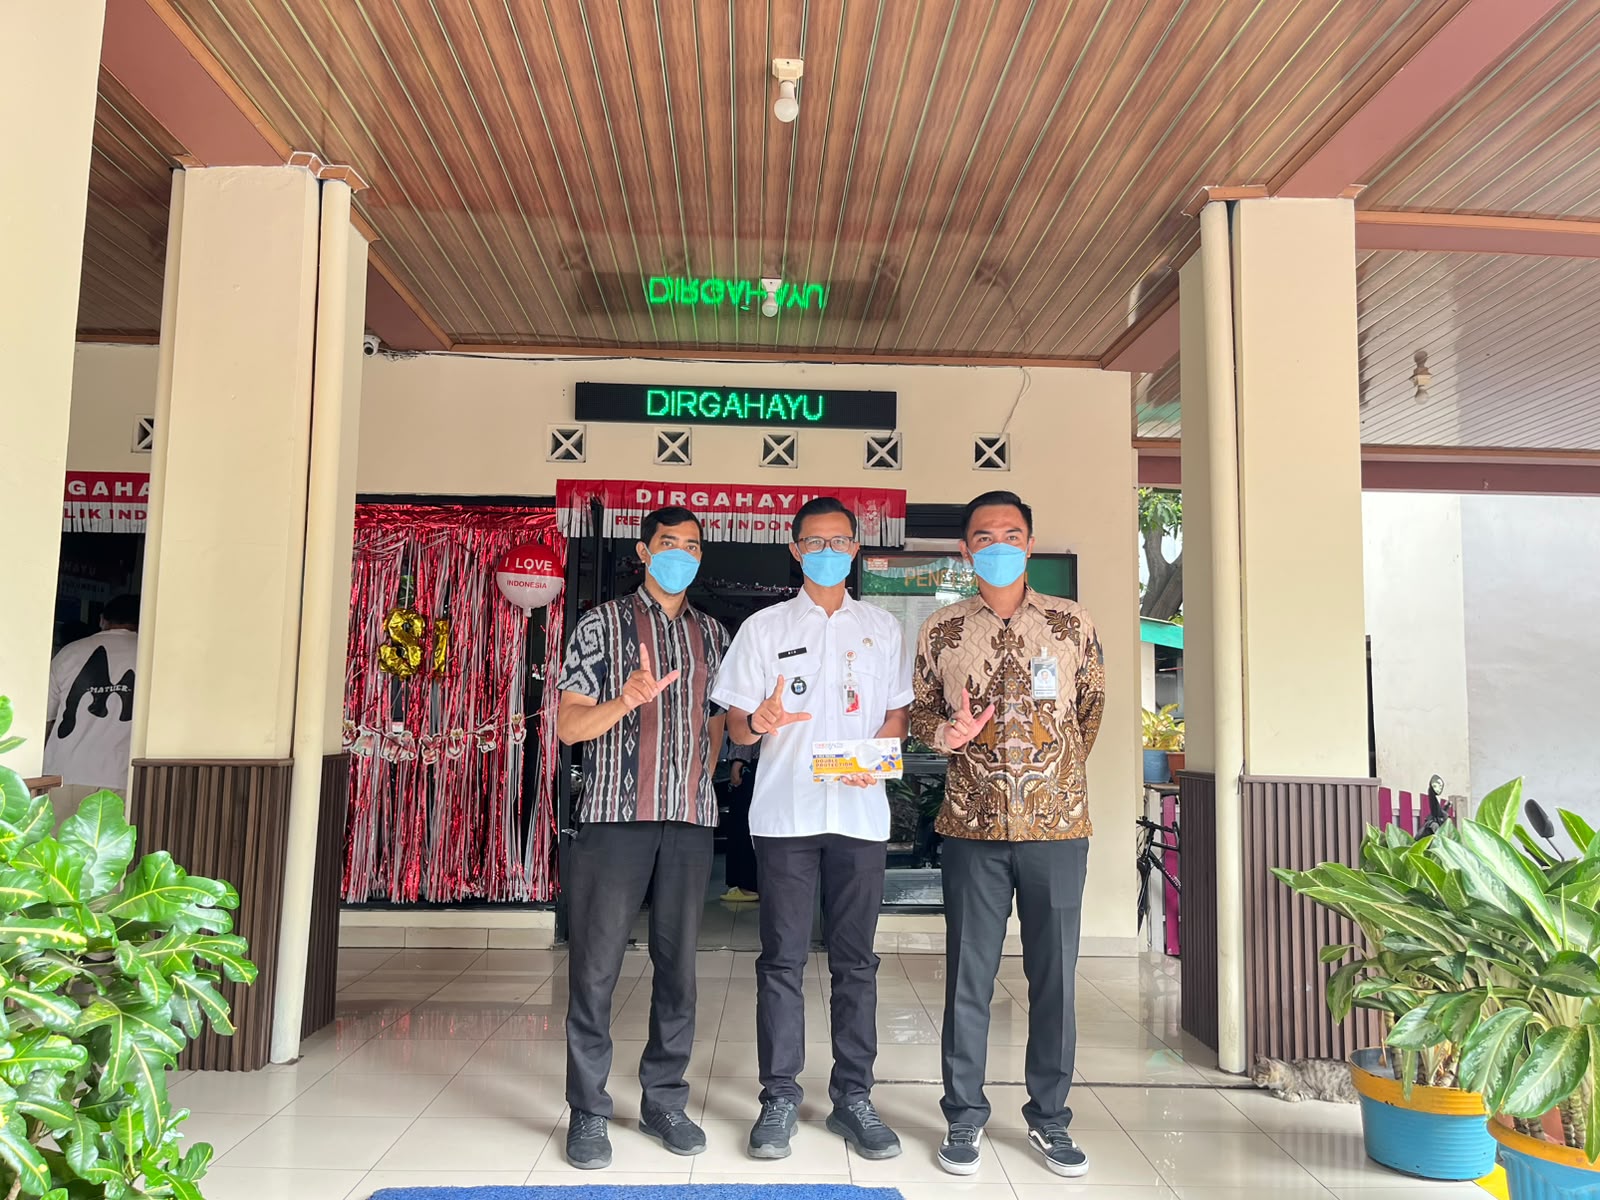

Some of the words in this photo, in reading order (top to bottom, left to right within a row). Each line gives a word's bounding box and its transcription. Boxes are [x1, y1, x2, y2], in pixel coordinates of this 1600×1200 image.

[646, 389, 823, 421] DIRGAHAYU
[504, 557, 509, 568] I
[515, 558, 553, 572] LOVE
[506, 580, 548, 589] INDONESIA
